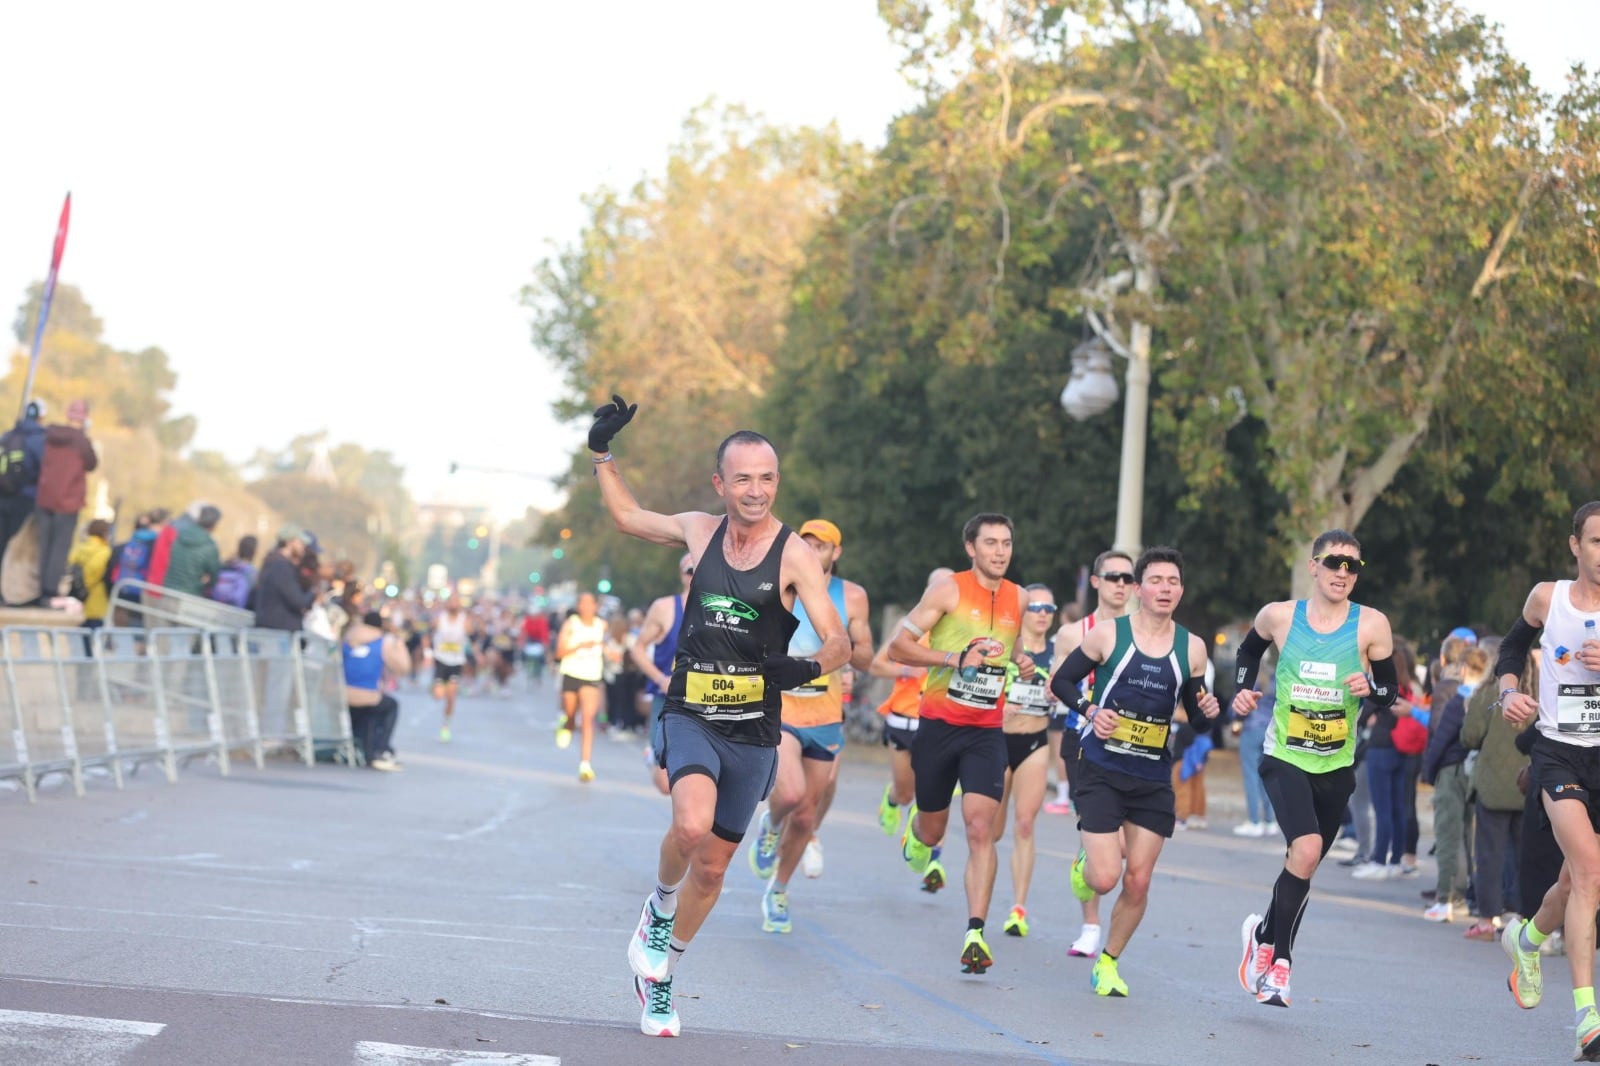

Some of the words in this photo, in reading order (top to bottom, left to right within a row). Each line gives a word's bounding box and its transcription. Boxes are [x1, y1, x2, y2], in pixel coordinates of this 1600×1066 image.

[712, 679, 735, 691] 604
[962, 684, 996, 696] PALOMERA
[1292, 685, 1313, 695] Winti
[1314, 688, 1330, 697] Run
[701, 693, 747, 703] JuCaBaLe
[1581, 712, 1587, 721] F
[1131, 723, 1149, 734] 577
[1130, 734, 1145, 744] Phil
[1304, 730, 1332, 742] Raphael
